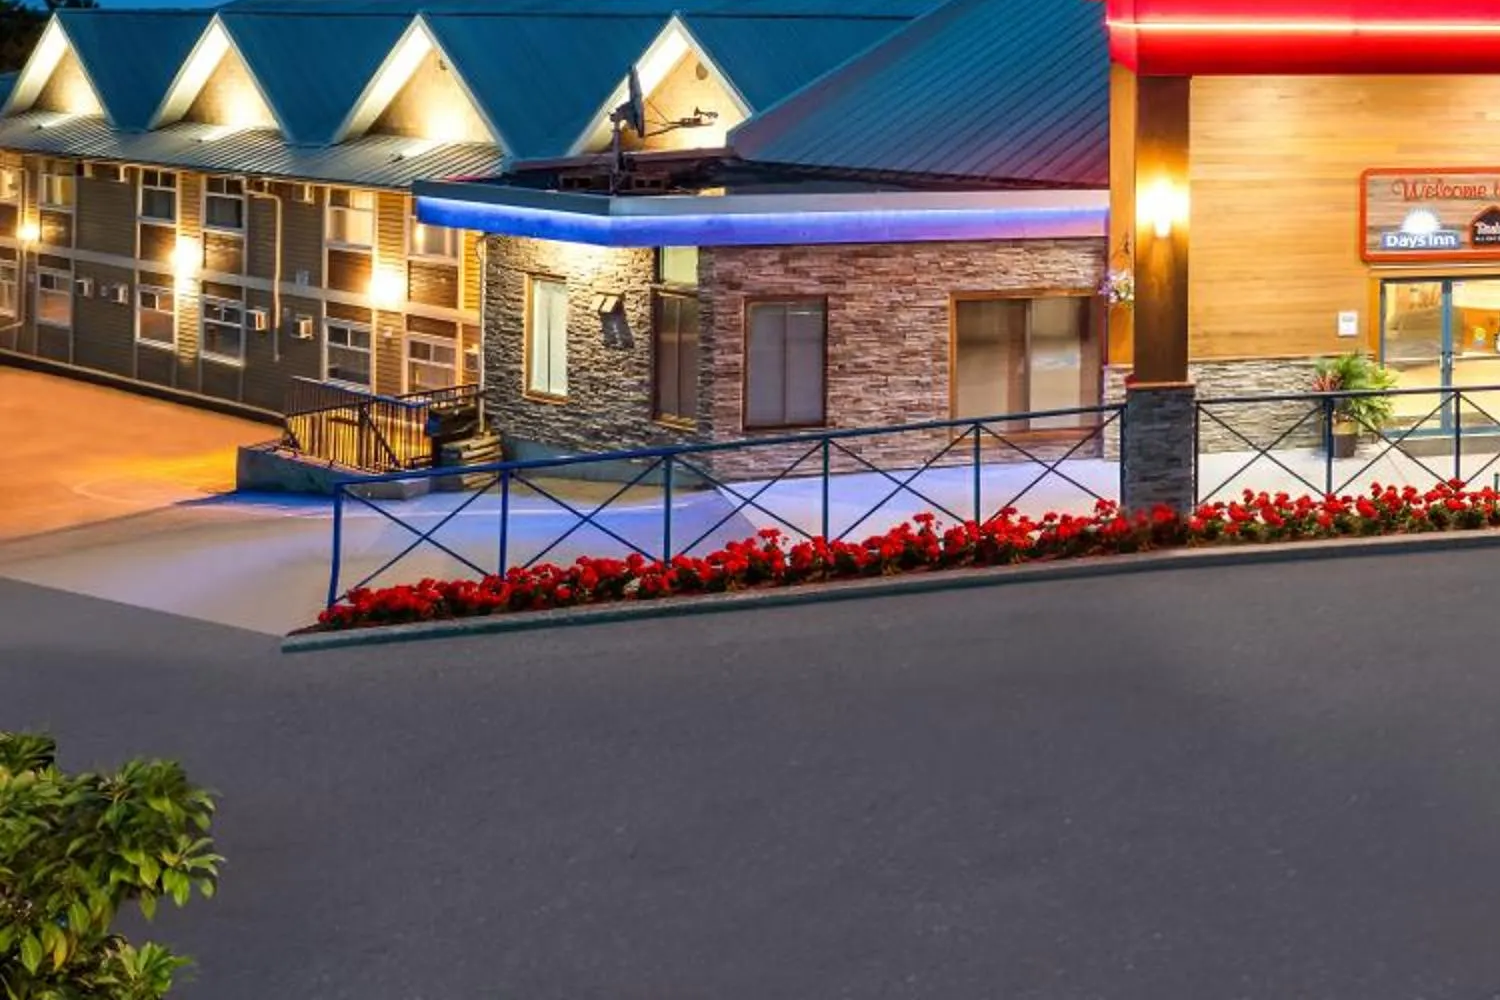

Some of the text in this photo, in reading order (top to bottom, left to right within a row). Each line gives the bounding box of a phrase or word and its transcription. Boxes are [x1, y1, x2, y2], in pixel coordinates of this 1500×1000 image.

[1391, 178, 1487, 202] Welcome
[1385, 232, 1457, 249] Days Inn
